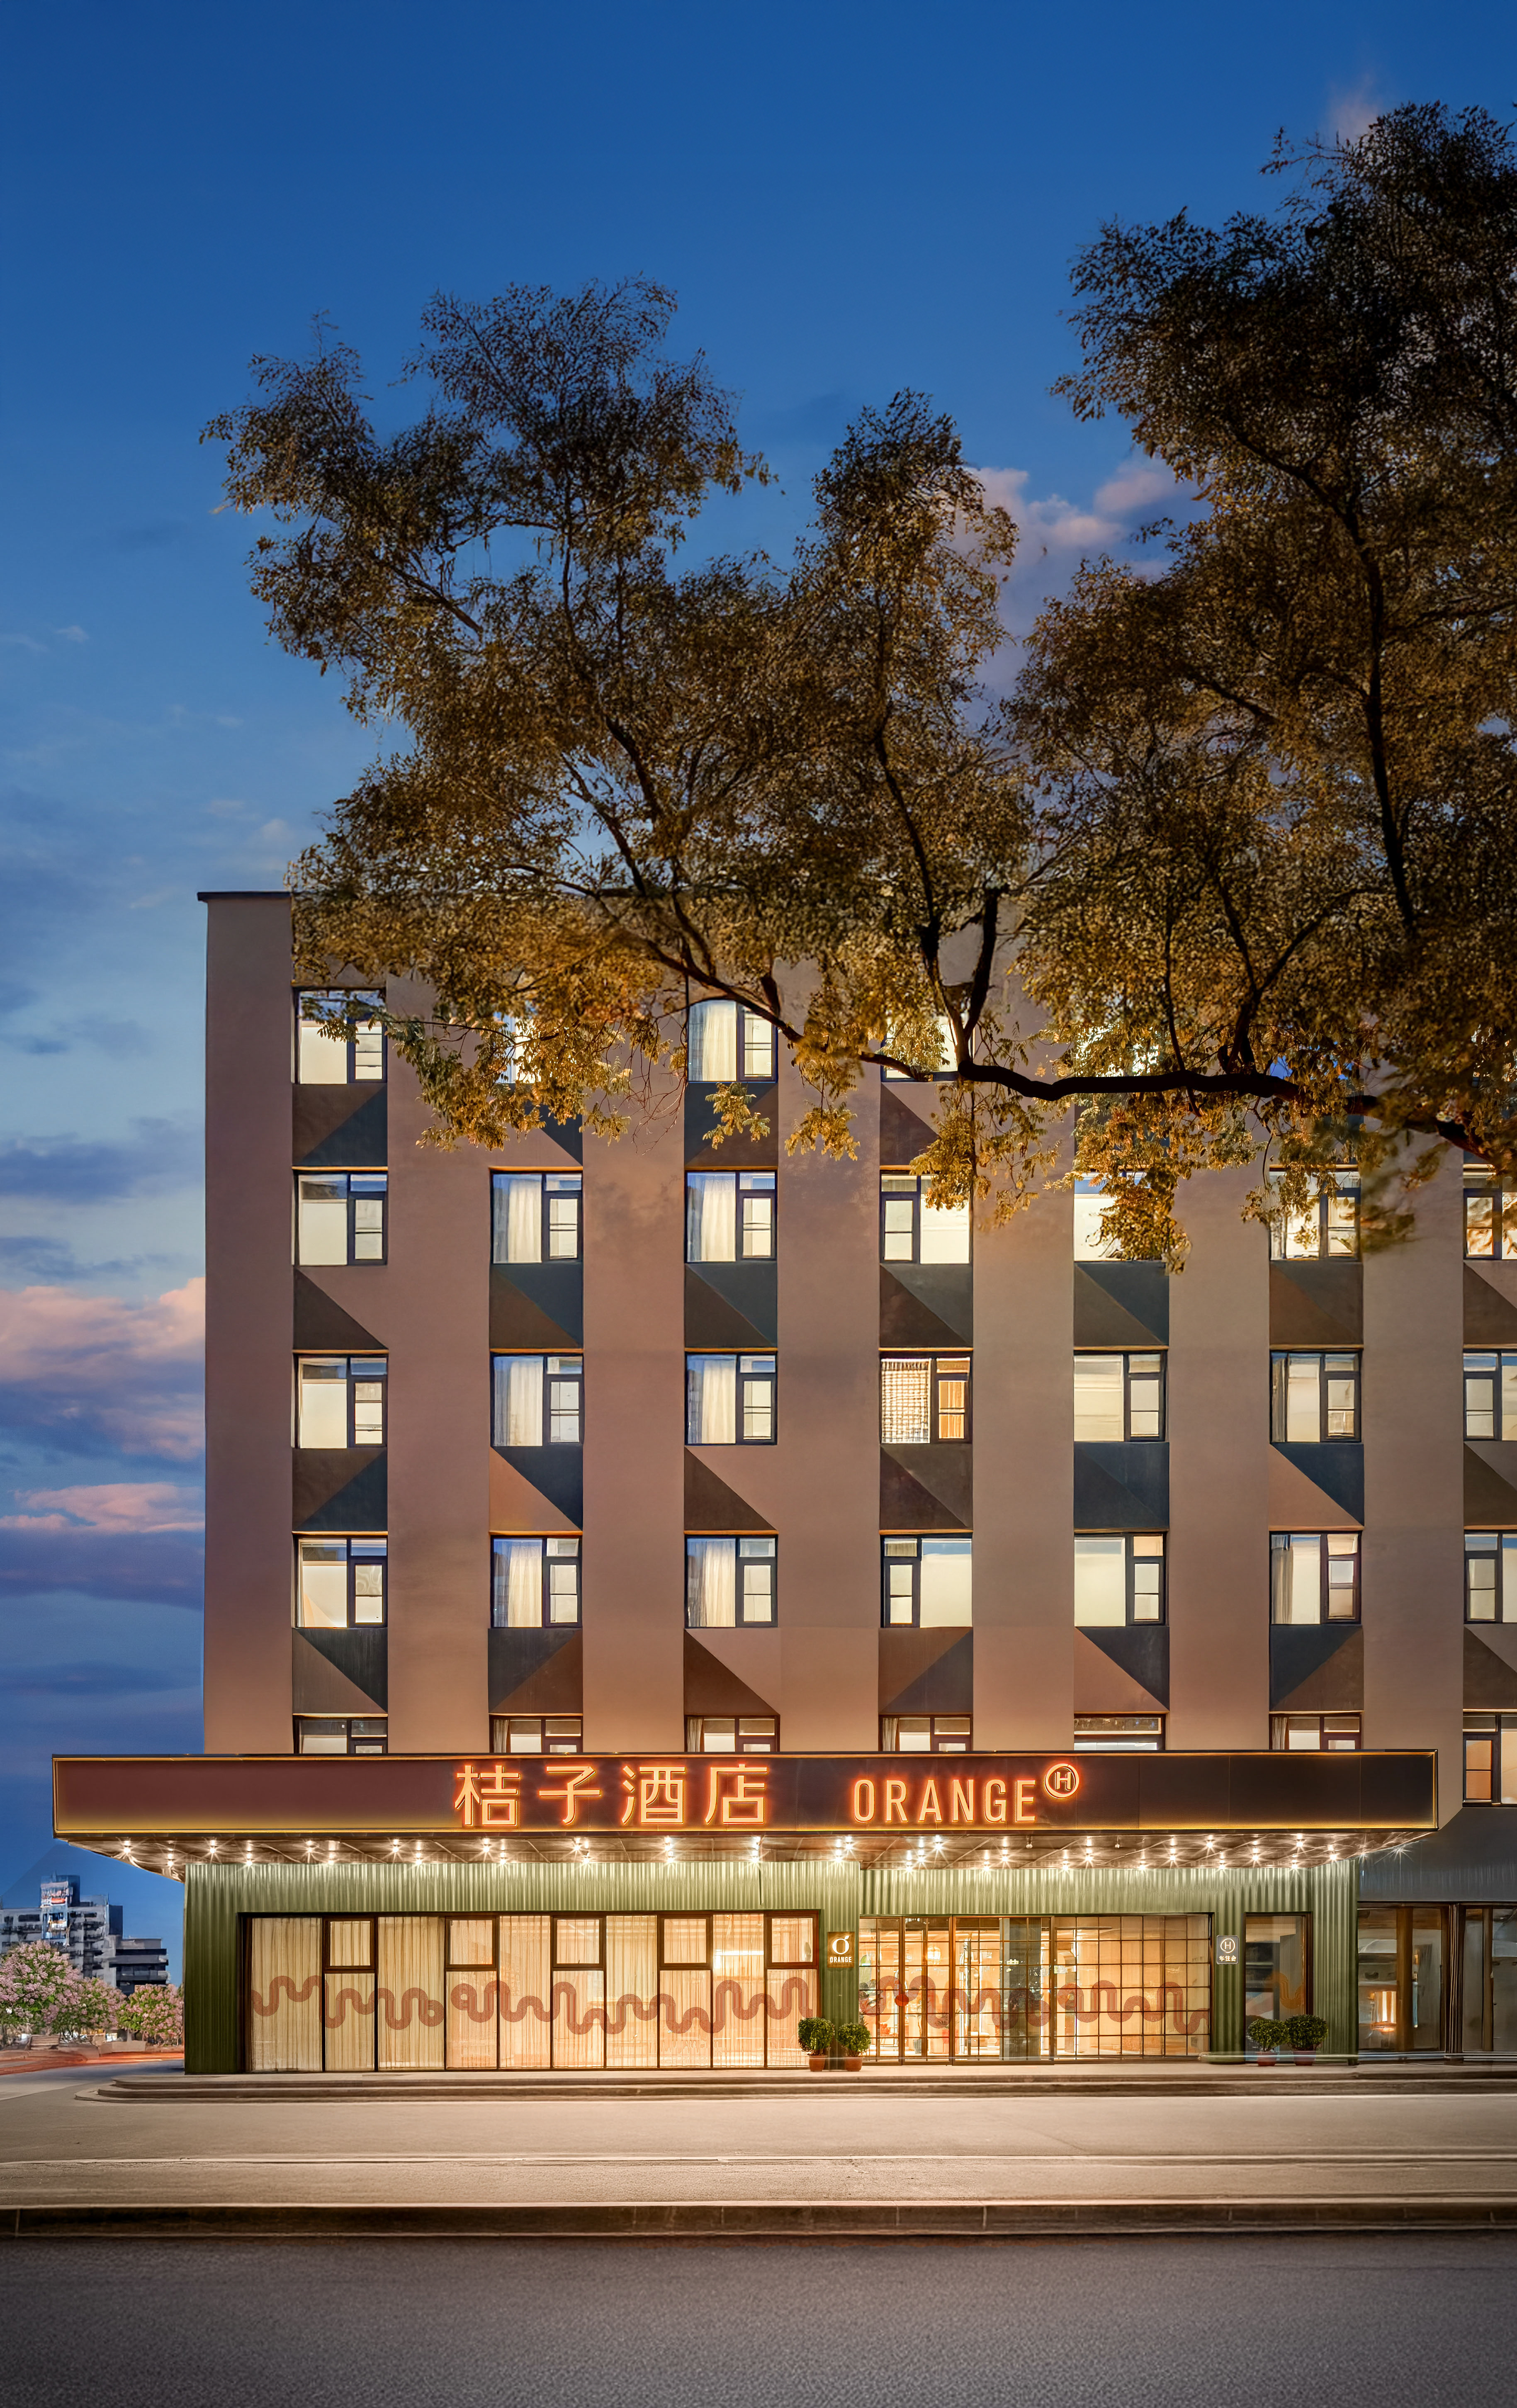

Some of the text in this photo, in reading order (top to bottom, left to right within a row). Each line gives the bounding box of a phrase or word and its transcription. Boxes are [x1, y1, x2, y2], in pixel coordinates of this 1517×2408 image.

[455, 1764, 769, 1826] 桔子酒店
[853, 1779, 1036, 1823] ORANGE
